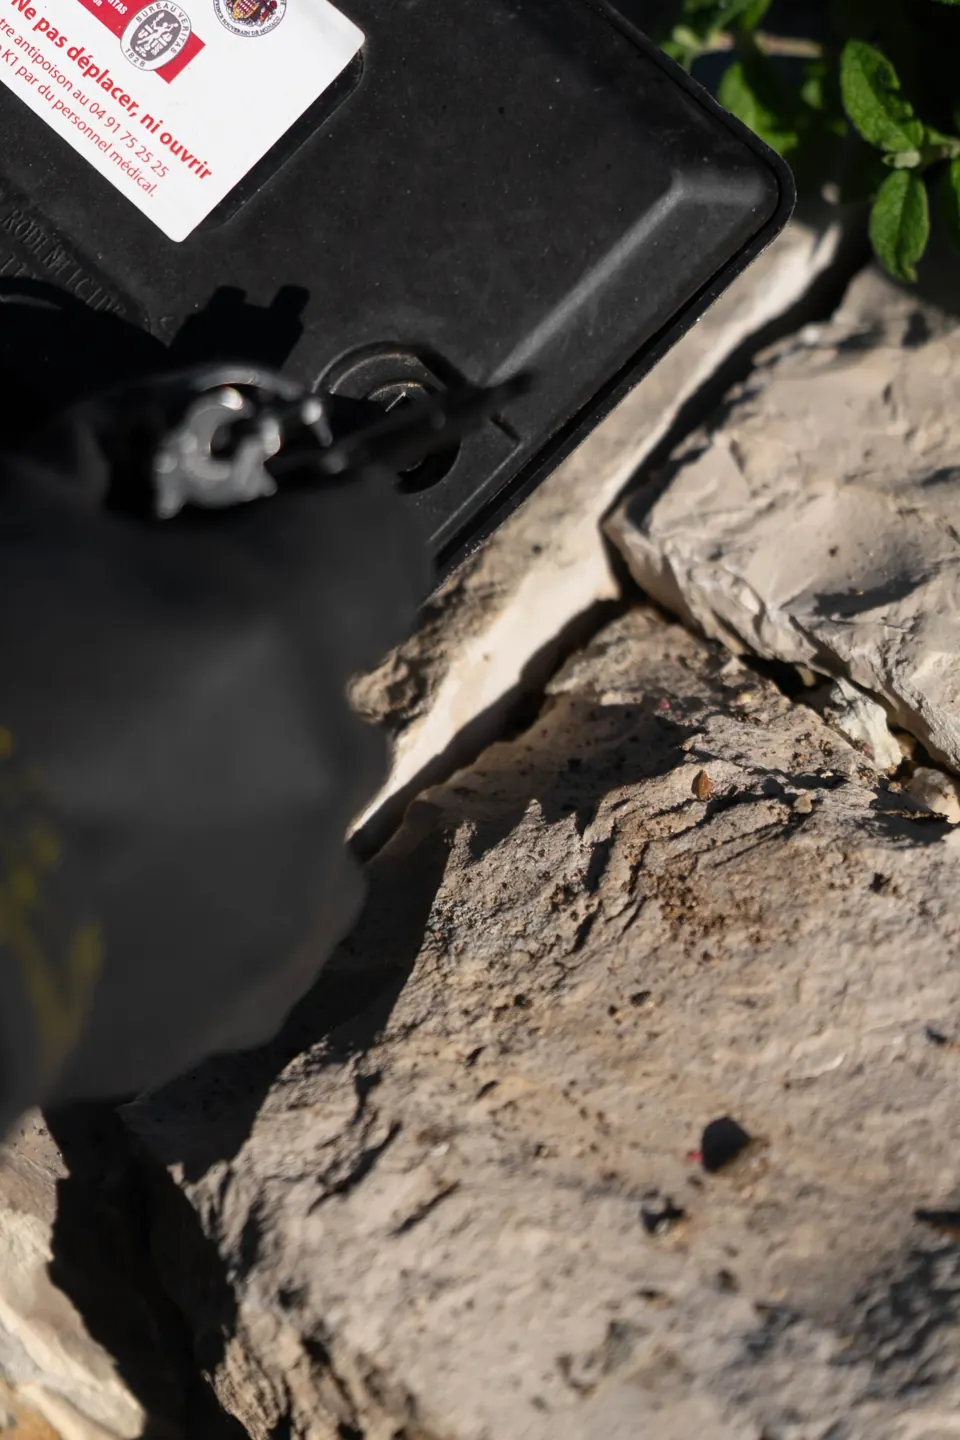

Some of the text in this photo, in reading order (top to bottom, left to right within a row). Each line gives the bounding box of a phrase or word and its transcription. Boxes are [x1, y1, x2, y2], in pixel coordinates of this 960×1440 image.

[32, 17, 67, 47] pas
[66, 46, 138, 117] déplacer,
[140, 113, 163, 133] ni
[159, 132, 211, 178] ouvrir
[125, 48, 145, 70] 1828
[134, 2, 189, 54] BUREAU VERITAS
[1, 48, 18, 66] K1
[14, 65, 38, 84] par
[37, 84, 54, 101] du
[51, 99, 112, 152] personnel
[109, 151, 158, 197] médical.
[13, 35, 72, 91] antipoison
[72, 89, 89, 105] au
[88, 102, 106, 119] 04
[104, 116, 120, 133] 91
[119, 130, 137, 148] 75
[134, 145, 153, 162] 25
[150, 159, 168, 177] 25
